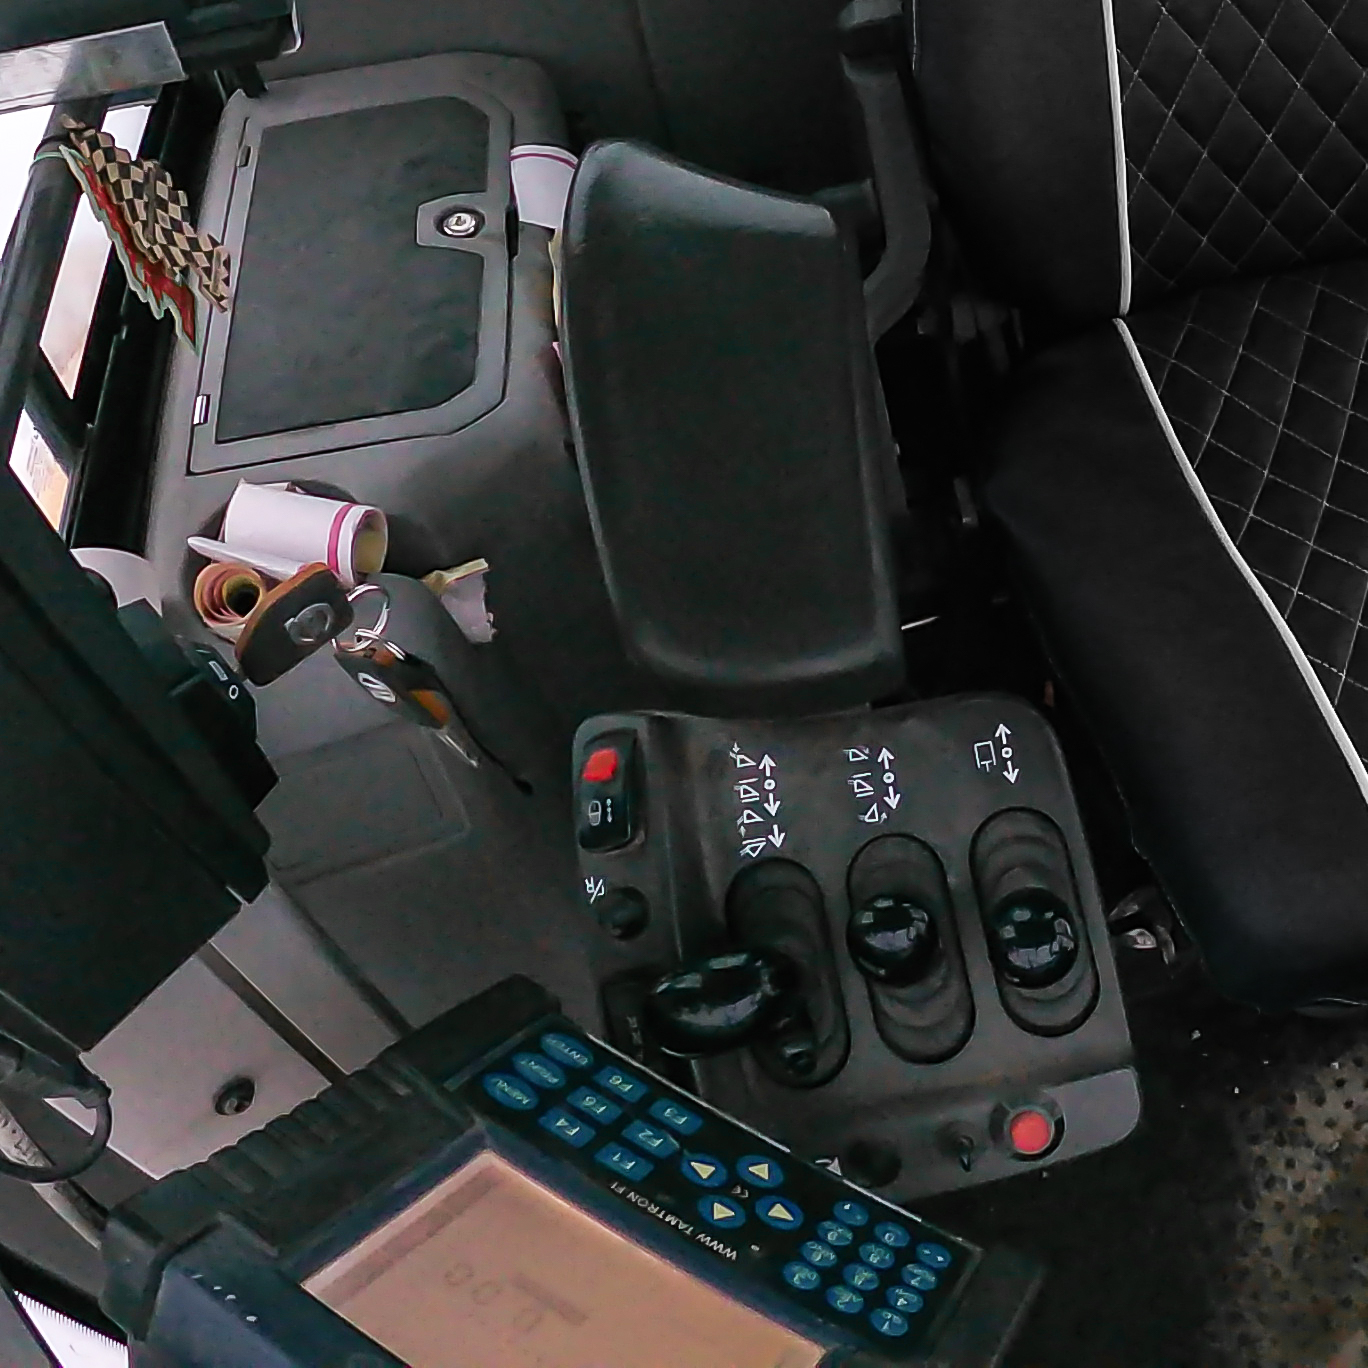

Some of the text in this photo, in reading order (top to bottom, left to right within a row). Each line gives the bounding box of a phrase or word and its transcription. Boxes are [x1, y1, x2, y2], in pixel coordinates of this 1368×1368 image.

[609, 1074, 633, 1092] F6
[556, 1117, 580, 1136] F4
[638, 1128, 663, 1148] F2
[612, 1152, 636, 1170] F1
